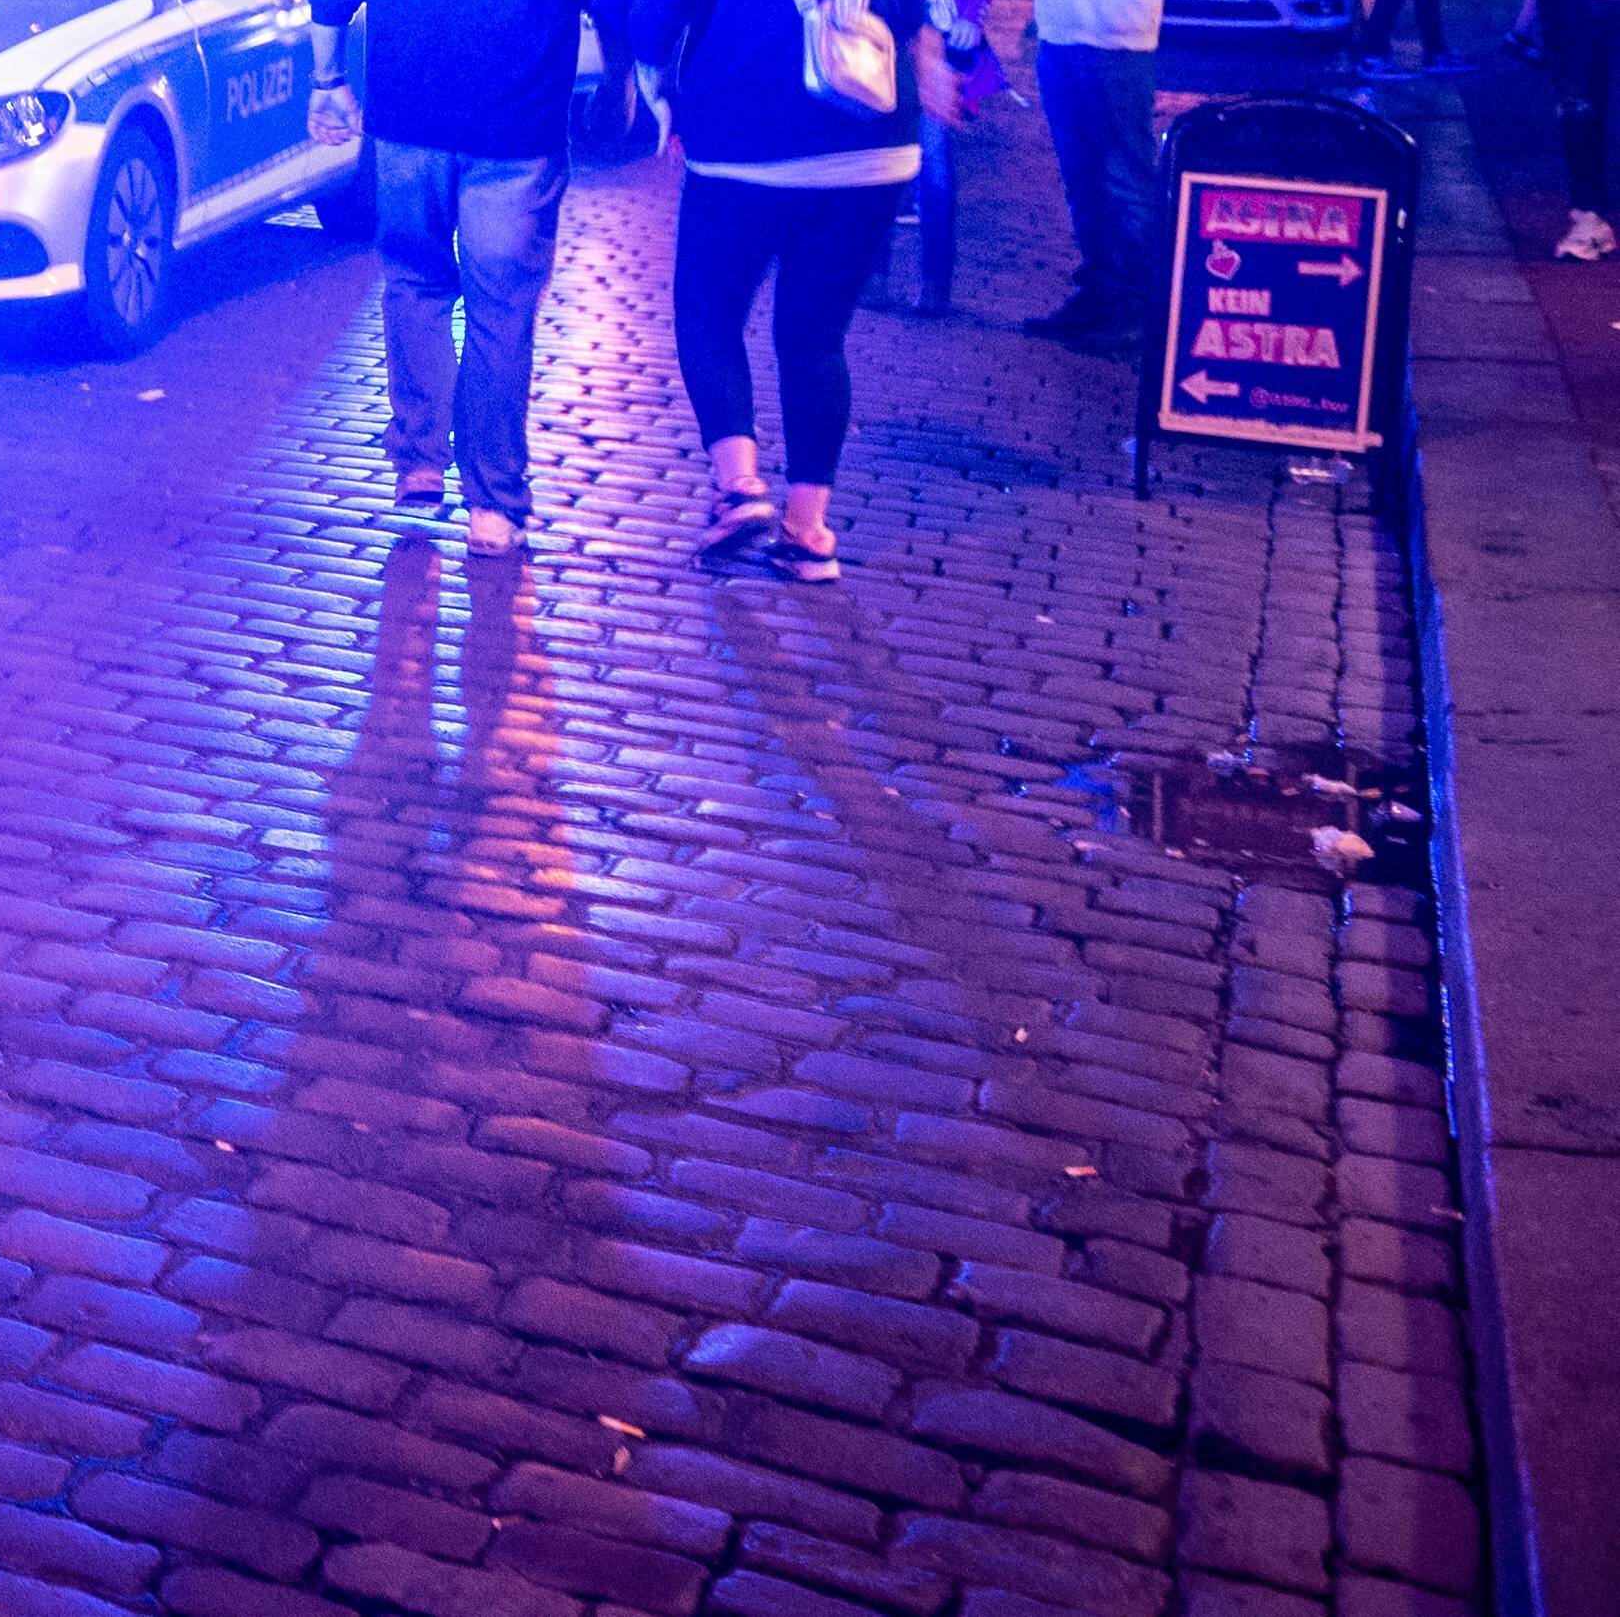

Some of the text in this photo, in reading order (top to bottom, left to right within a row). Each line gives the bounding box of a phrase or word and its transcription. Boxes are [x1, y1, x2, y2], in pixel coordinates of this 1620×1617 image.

[226, 57, 294, 123] POLIZEI
[1205, 198, 1351, 245] ASTRA
[1208, 286, 1272, 318] KEIN
[1191, 318, 1341, 370] ASTRA
